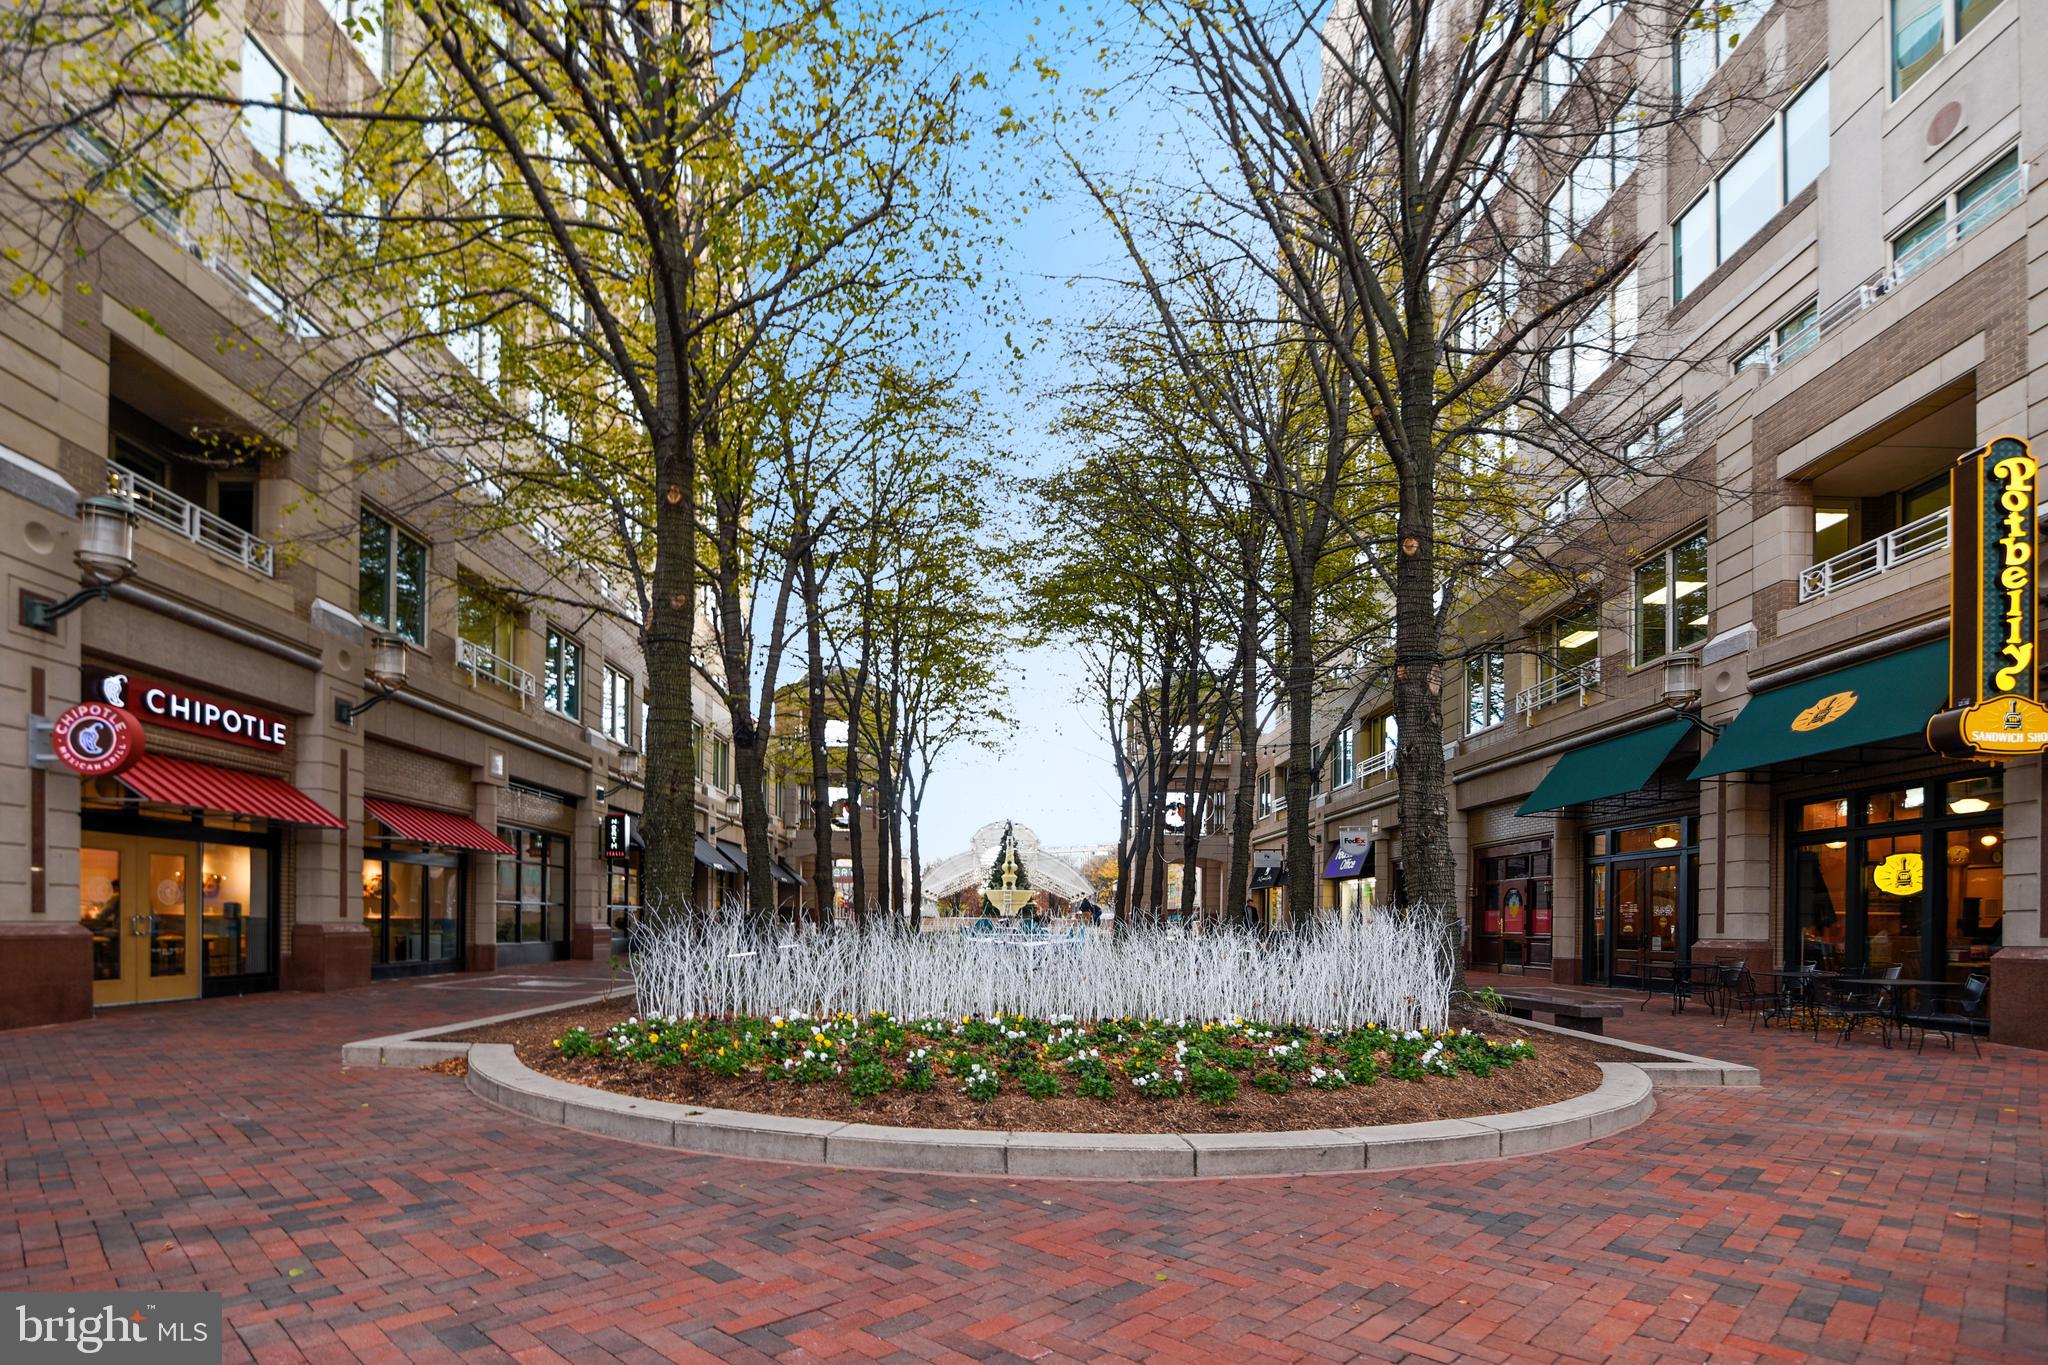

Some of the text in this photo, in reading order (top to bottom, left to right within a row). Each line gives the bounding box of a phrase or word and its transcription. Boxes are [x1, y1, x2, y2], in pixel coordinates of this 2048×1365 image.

[1994, 457, 2037, 691] Potbelly
[55, 705, 127, 735] CHIPOTLE
[146, 688, 286, 745] CHIPOTLE
[1972, 731, 2025, 743] SANDWICH
[60, 744, 126, 771] MEXICAN GRILL
[1344, 837, 1366, 845] FedEx
[1339, 858, 1356, 871] Office
